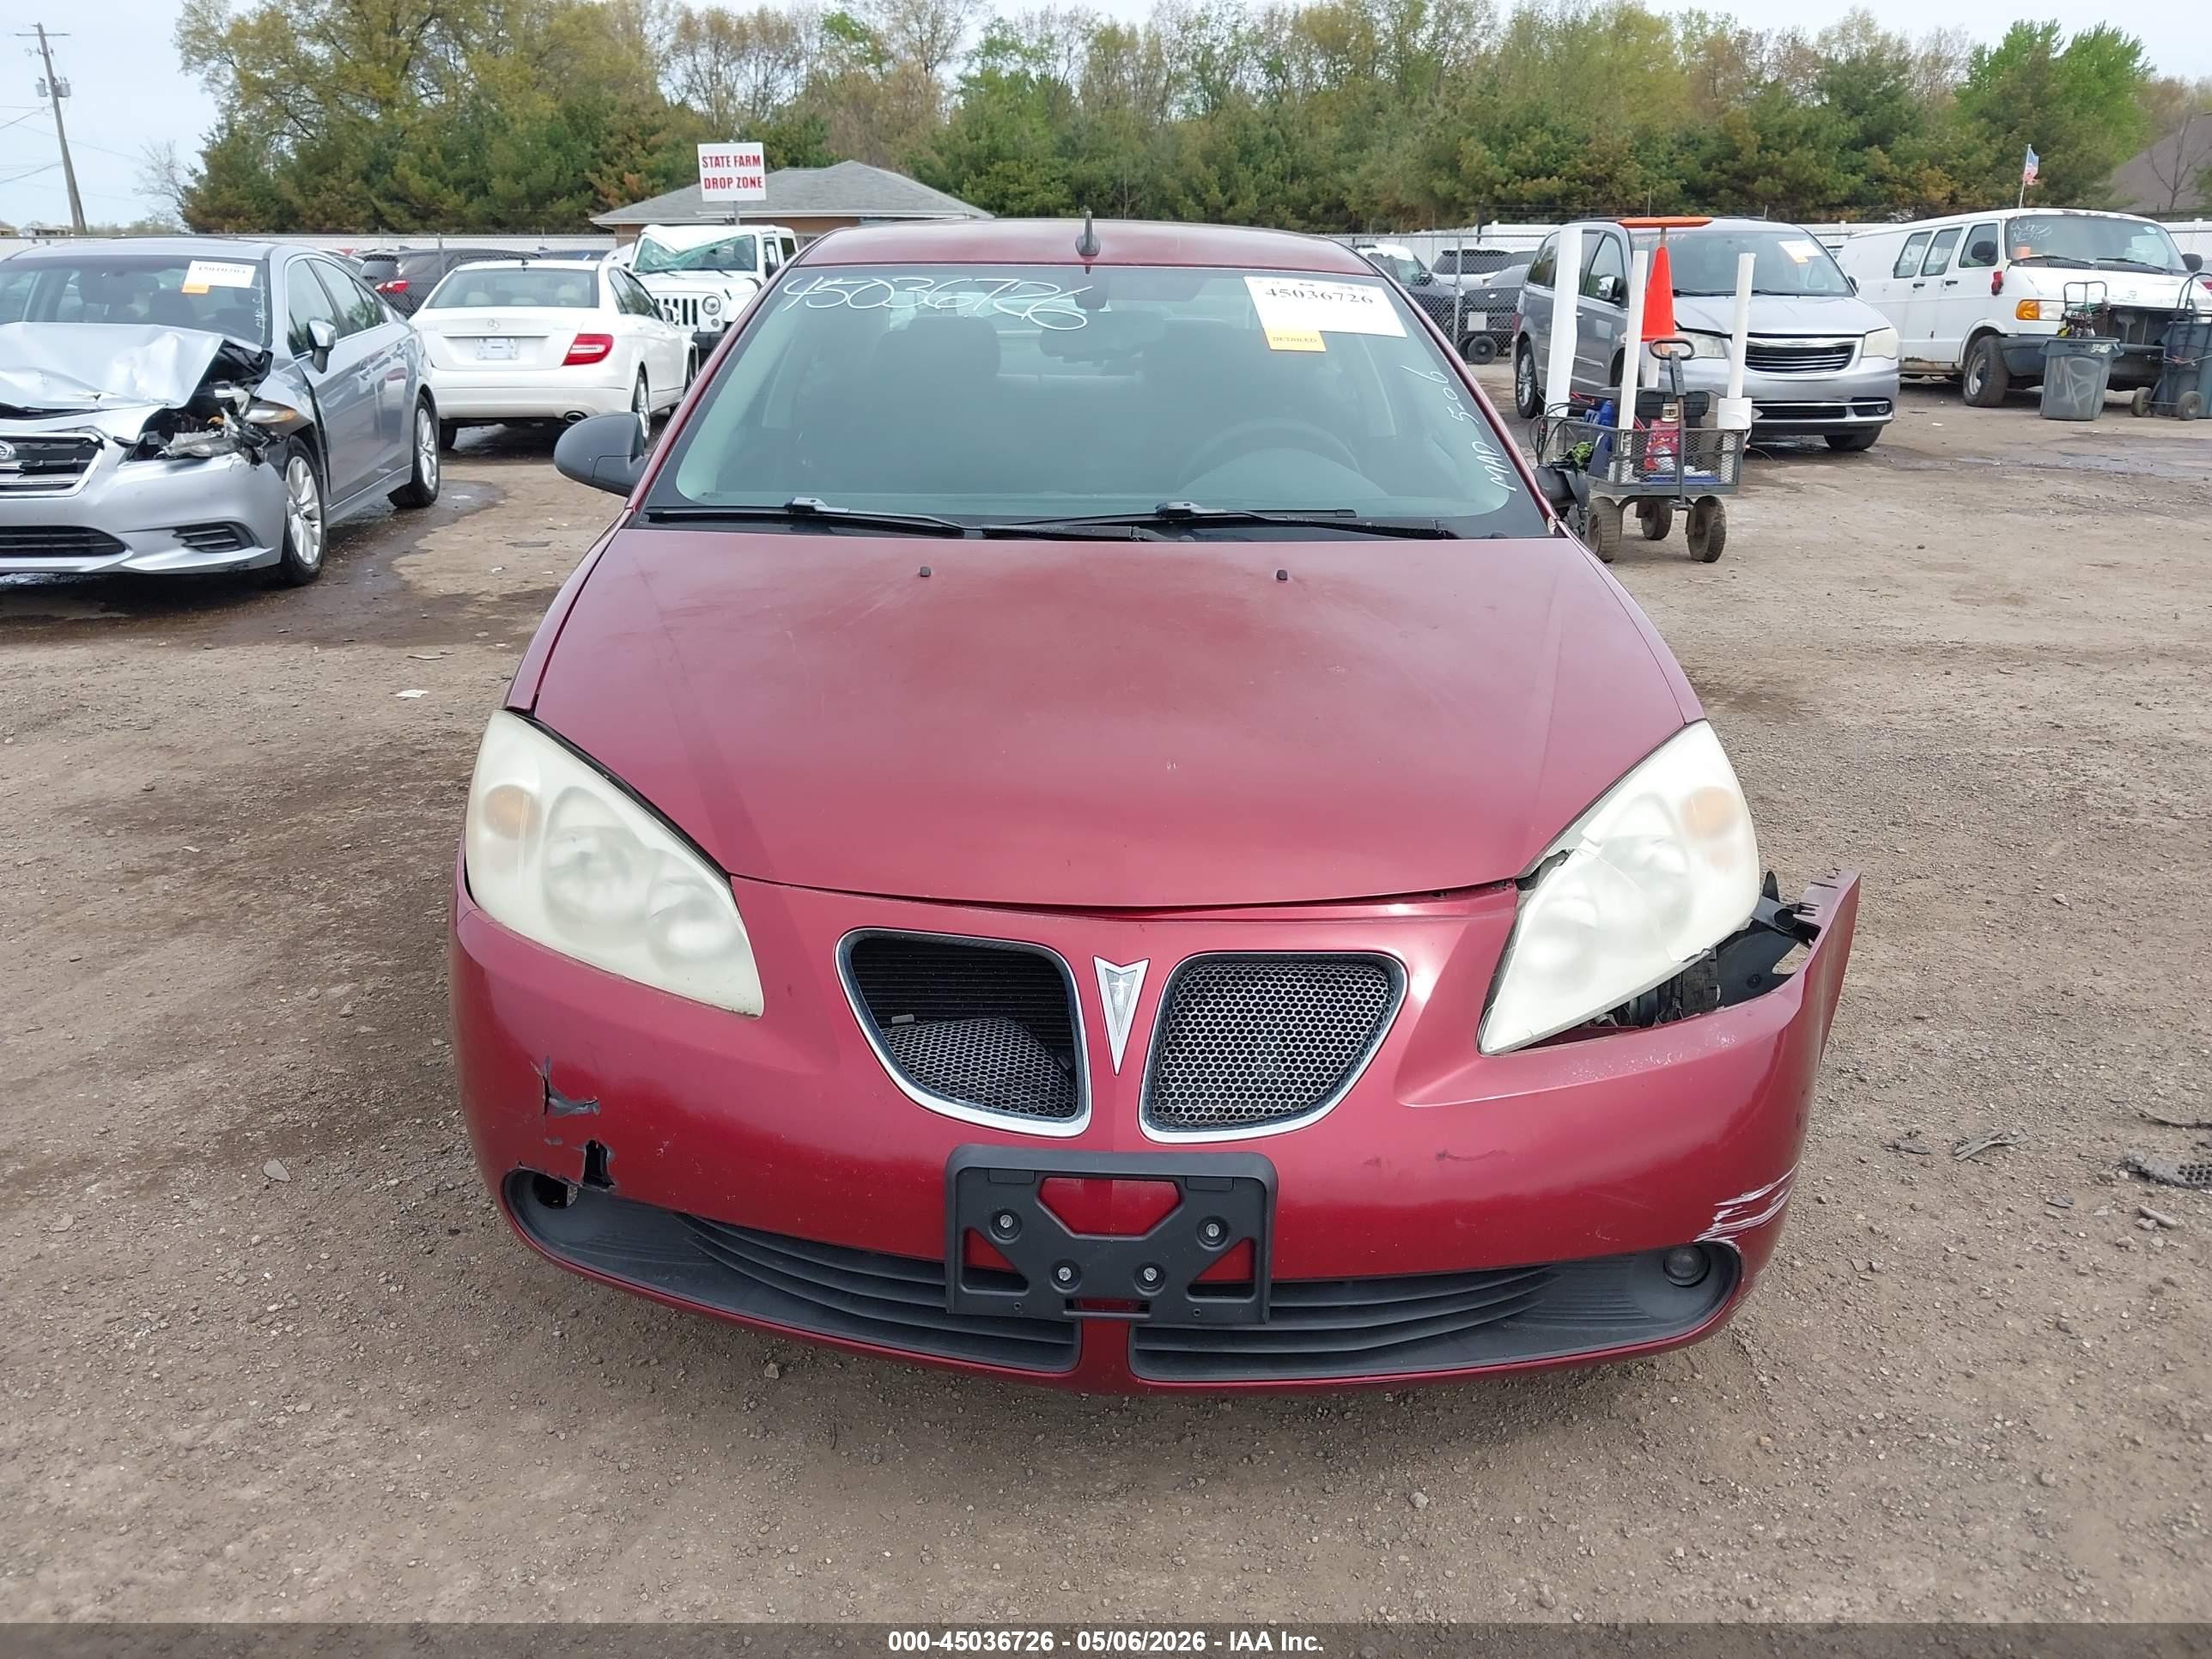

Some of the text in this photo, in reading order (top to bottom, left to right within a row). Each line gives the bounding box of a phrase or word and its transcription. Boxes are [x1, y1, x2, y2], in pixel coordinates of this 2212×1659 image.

[702, 155, 761, 168] STATE FARM
[704, 176, 763, 190] DROP ZONE
[782, 276, 1093, 331] 45036726
[1265, 287, 1375, 305] 45036726
[1401, 364, 1480, 425] 5-06
